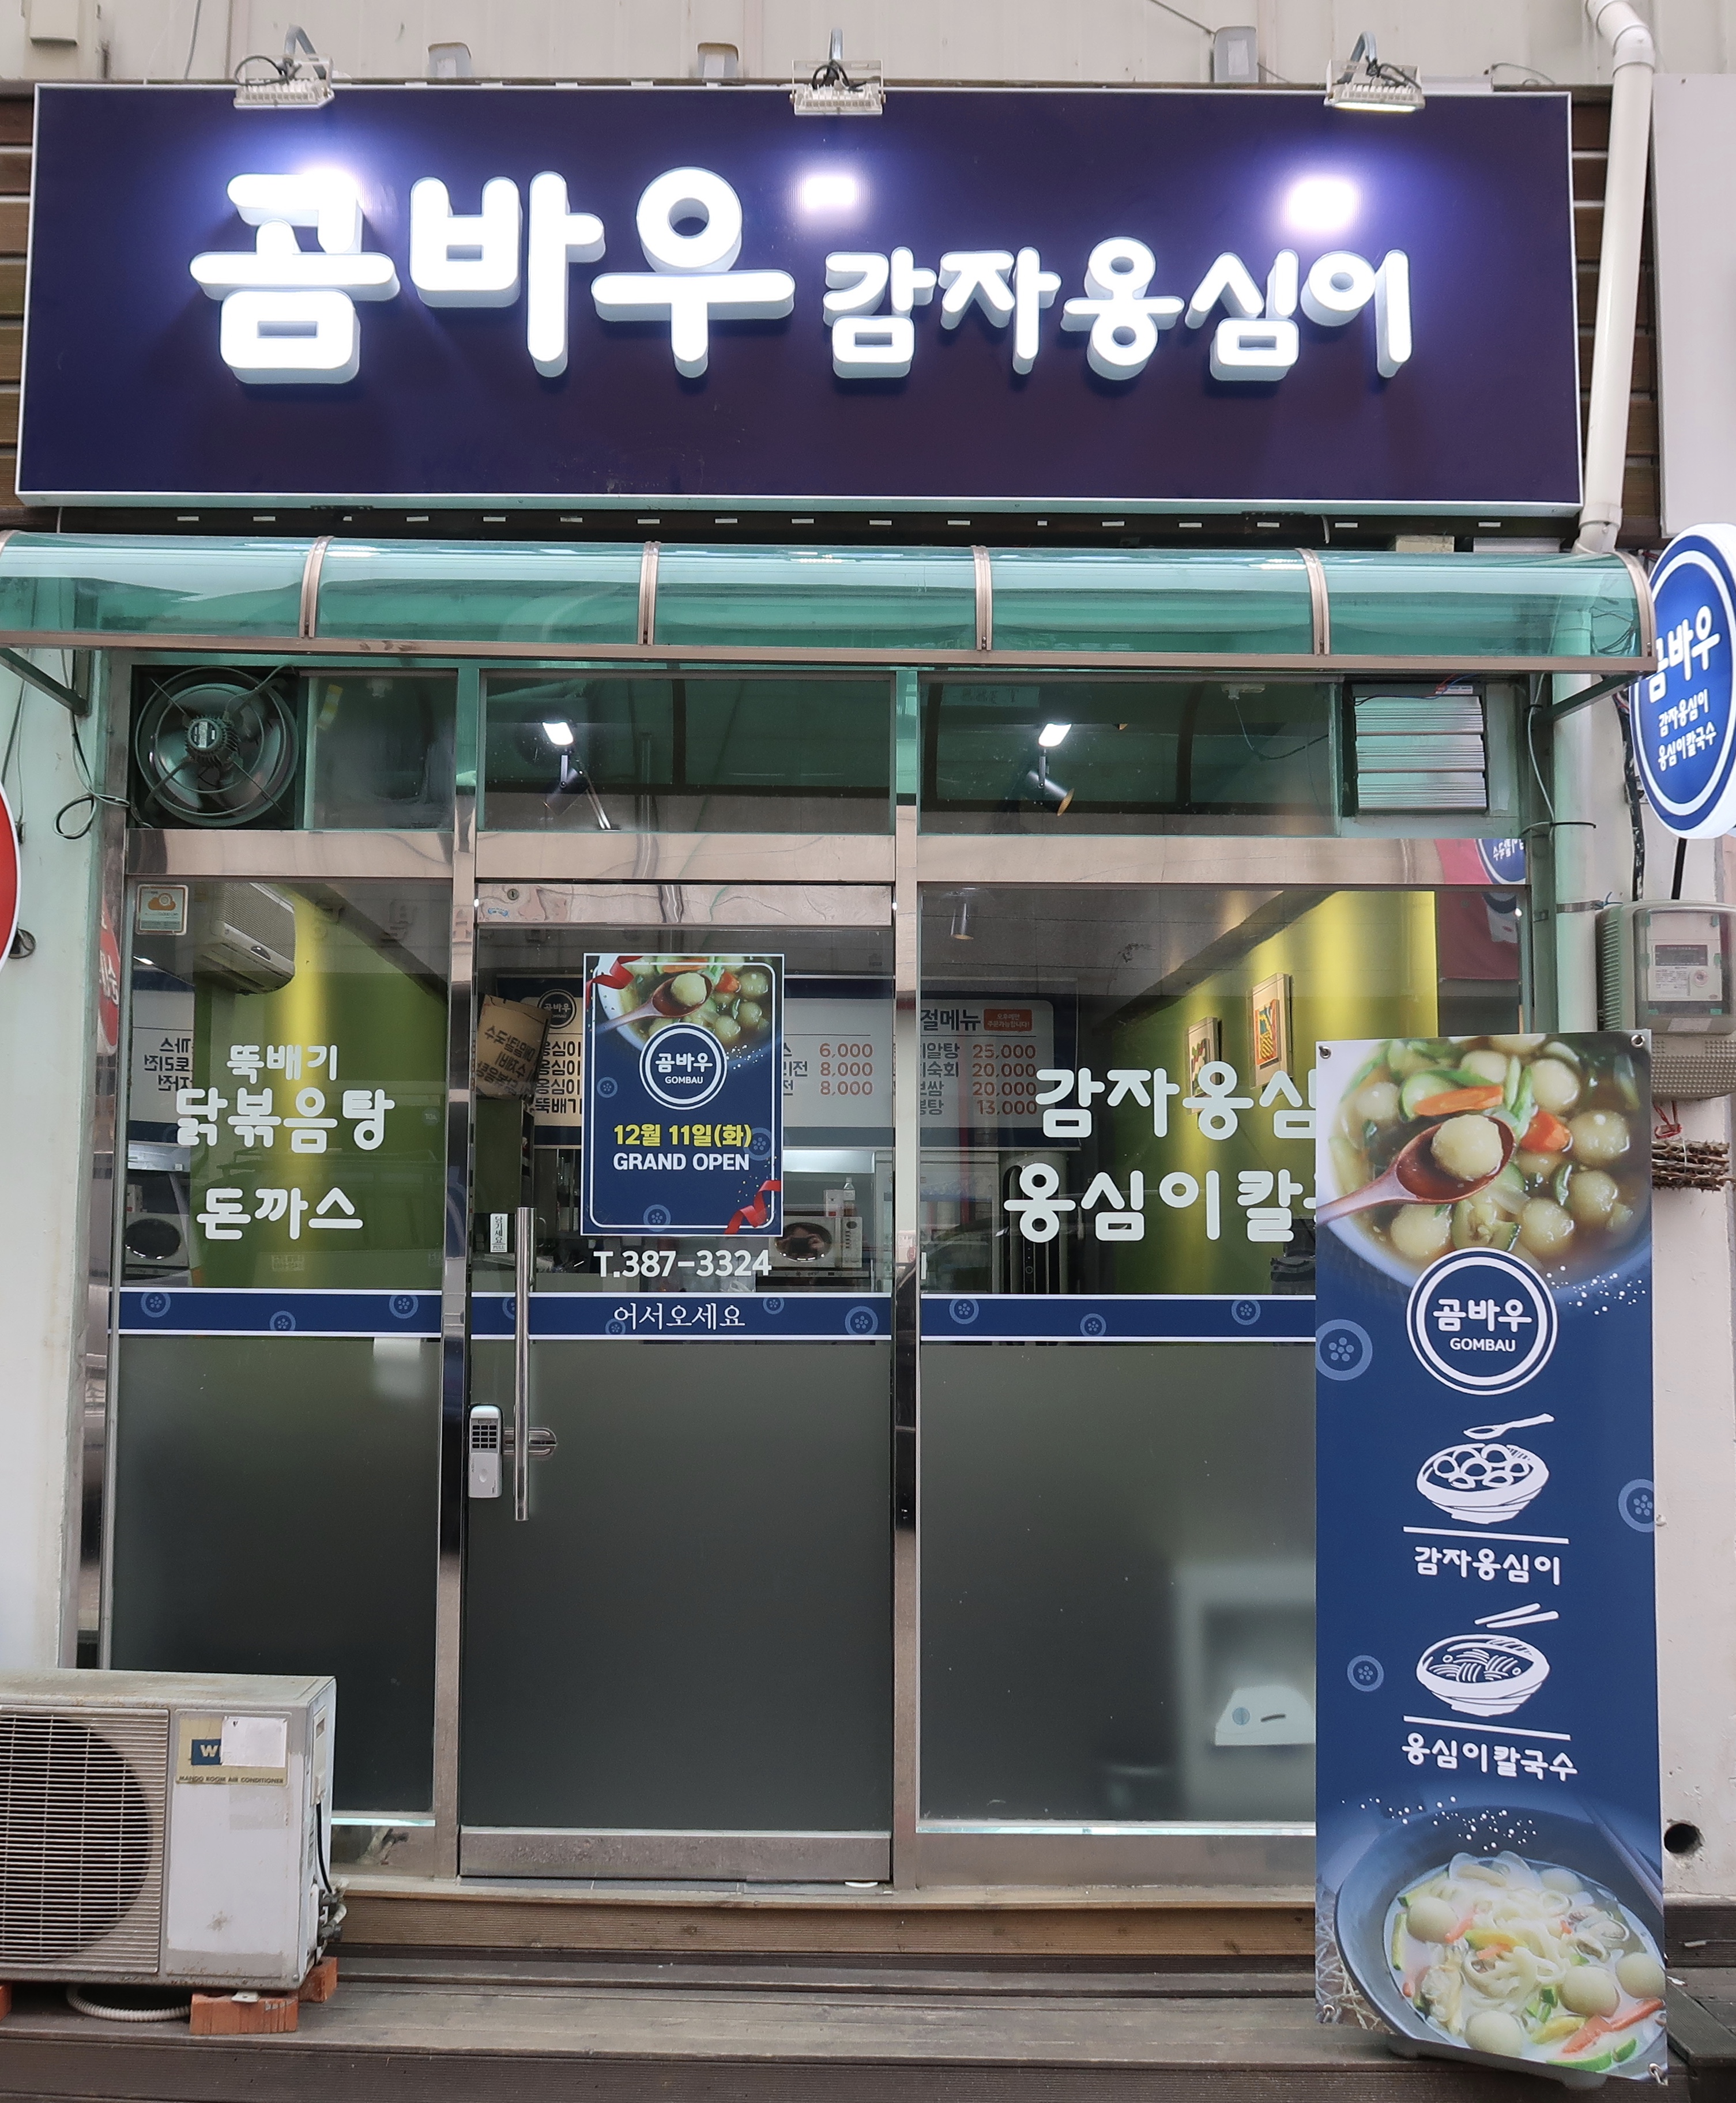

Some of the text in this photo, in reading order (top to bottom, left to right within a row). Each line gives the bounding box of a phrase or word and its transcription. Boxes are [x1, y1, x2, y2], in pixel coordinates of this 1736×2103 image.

[190, 167, 1412, 383] 곰바우 감자옹심이
[1658, 688, 1709, 738] 감자옹심이
[1658, 721, 1717, 771] 옹심이칼국수
[921, 1009, 981, 1031] 절메뉴
[819, 1042, 873, 1058] 6,000
[972, 1044, 1036, 1060] 25,000
[227, 1044, 338, 1084] 뚝배기
[655, 1052, 713, 1073] 곰바우
[820, 1061, 873, 1077] 8,000
[972, 1062, 1037, 1078] 20,000
[665, 1076, 704, 1085] GOMBAU
[820, 1080, 873, 1096] 8,000
[972, 1081, 1037, 1097] 20,000
[535, 1097, 582, 1114] 뚝배기
[977, 1100, 1037, 1115] 13,000
[175, 1087, 396, 1154] 닭볶음탕
[613, 1124, 752, 1147] 12월 11일(화)
[613, 1152, 750, 1171] GRAND OPEN
[196, 1187, 364, 1240] 돈까스
[1003, 1162, 1316, 1243] 옹심이칼
[593, 1250, 772, 1278] T.387-3324
[612, 1302, 746, 1330] 어서오세요
[1433, 1298, 1532, 1332] 곰바우
[1450, 1337, 1516, 1353] GOMBAU
[1414, 1546, 1561, 1585] 감자옹심이
[1402, 1732, 1578, 1781] 옹심이칼국수
